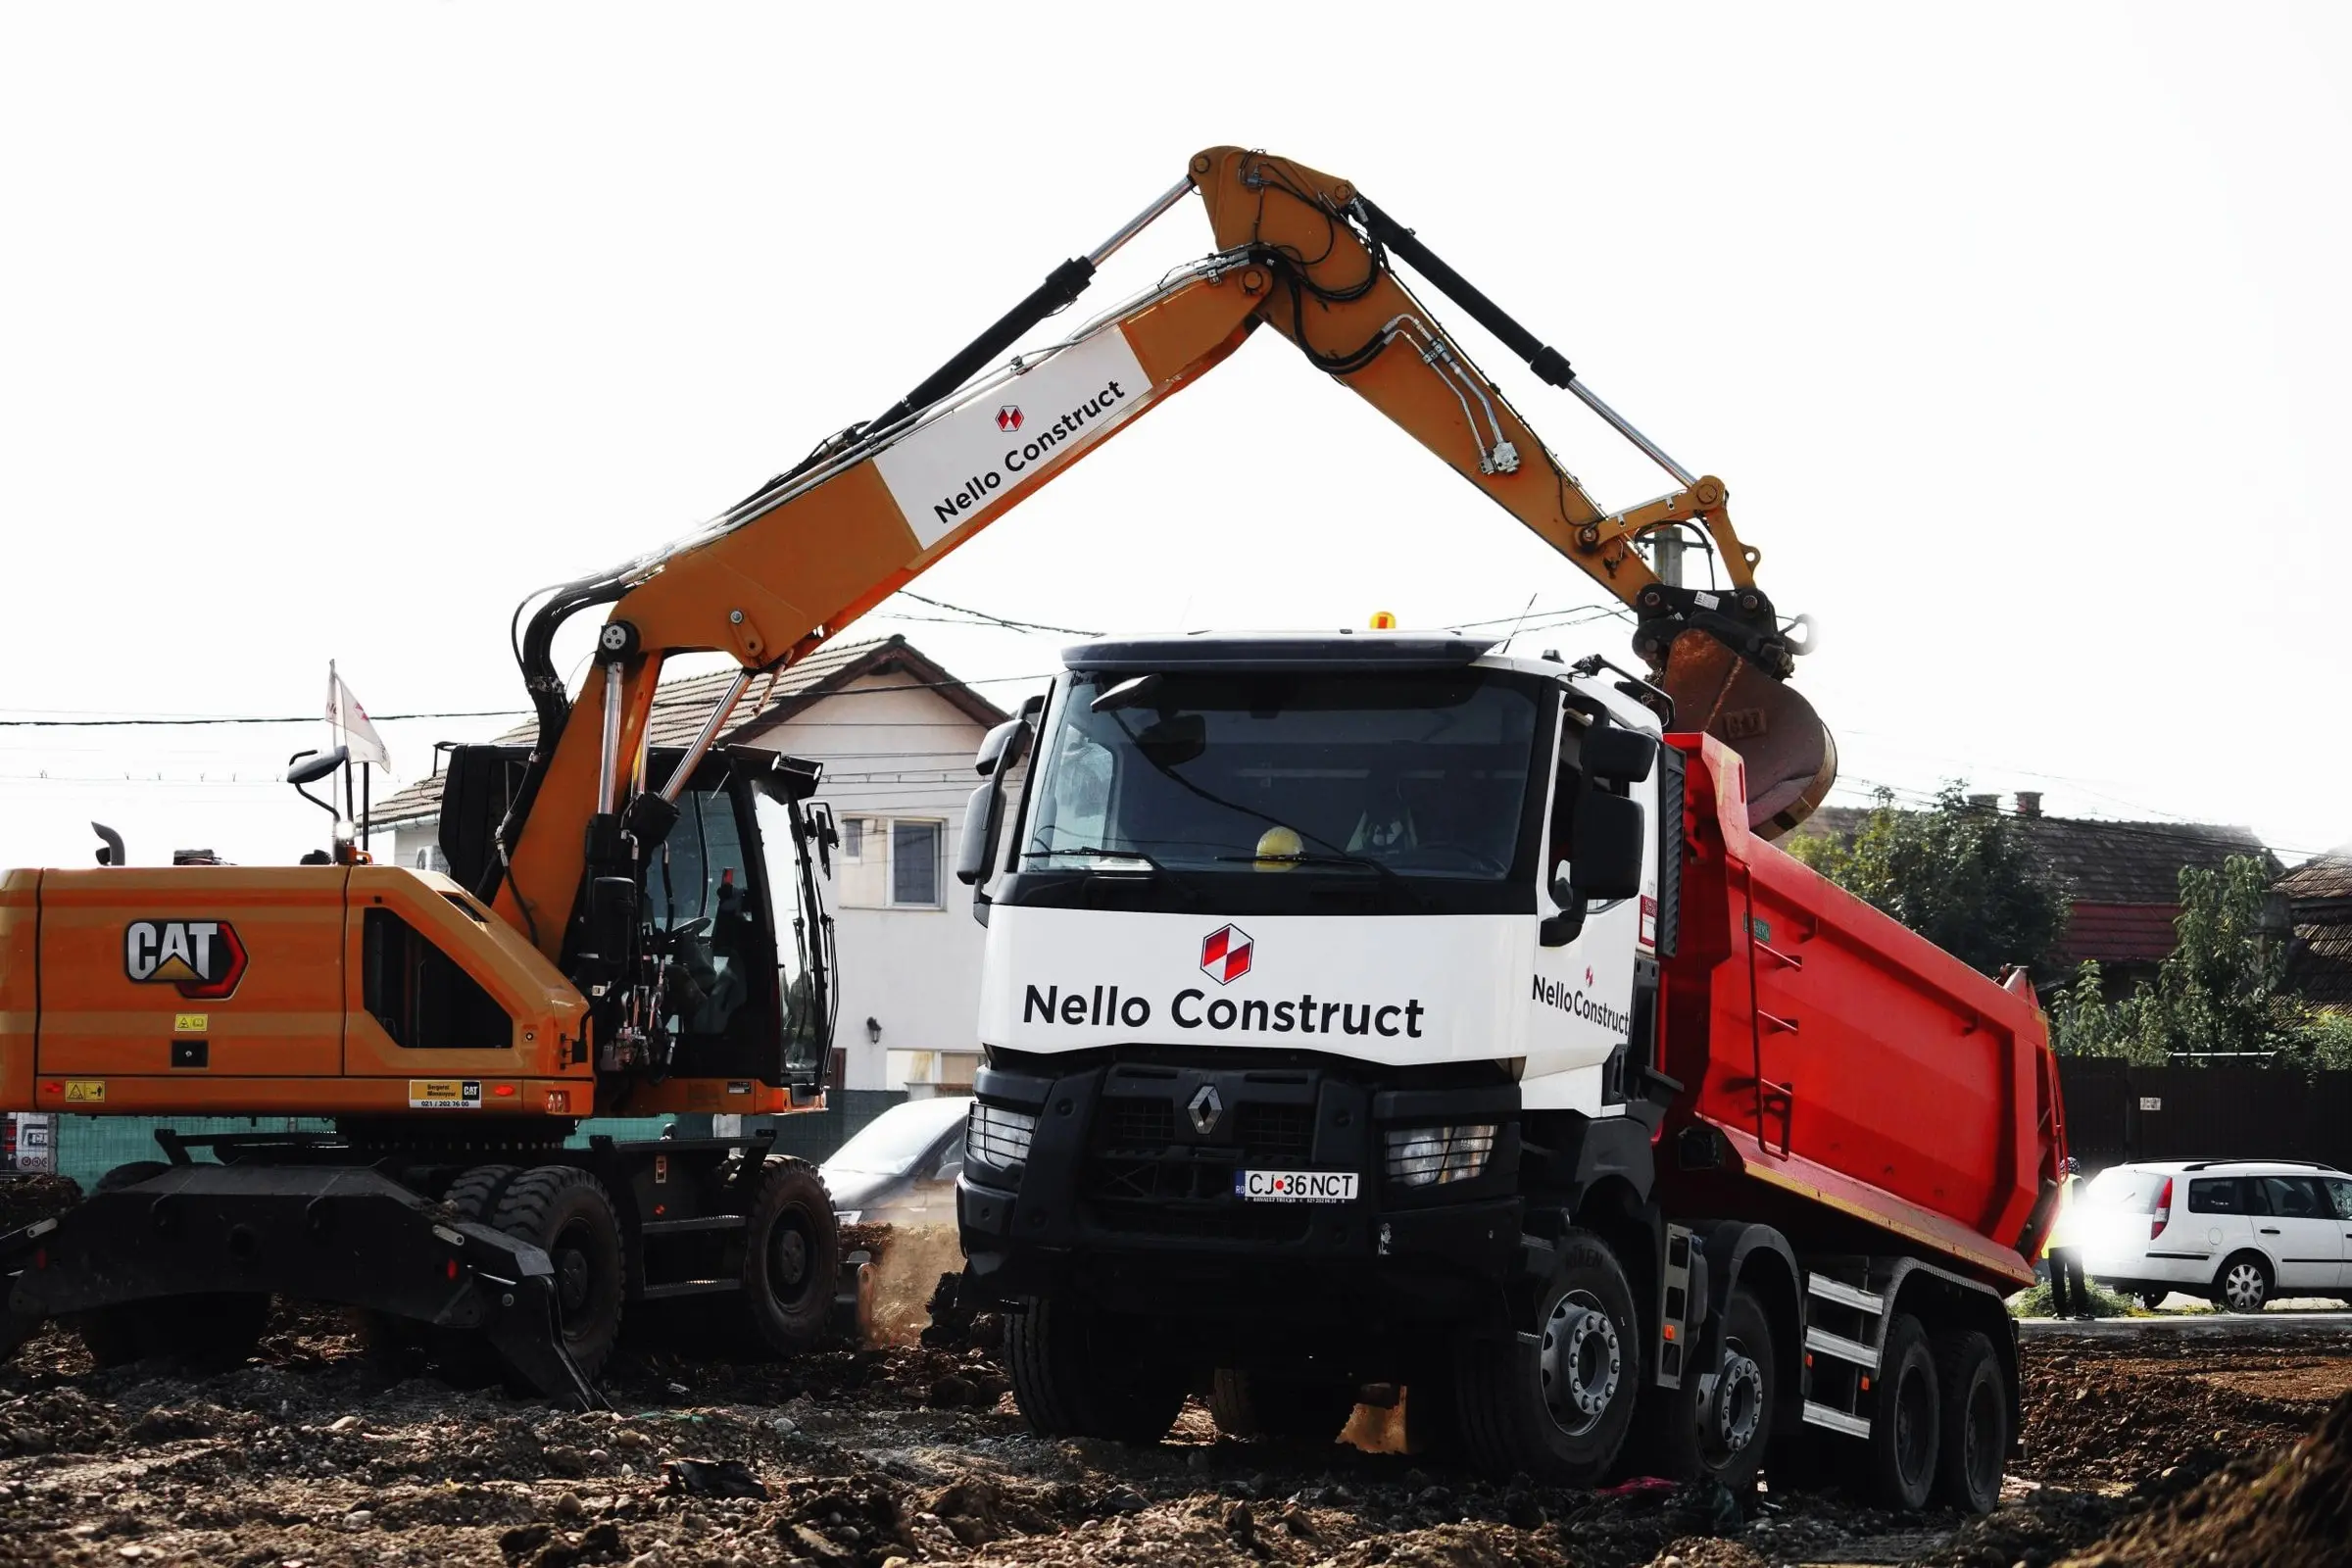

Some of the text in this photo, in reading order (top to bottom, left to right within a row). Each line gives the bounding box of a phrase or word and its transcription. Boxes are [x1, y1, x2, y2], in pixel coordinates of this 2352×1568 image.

[934, 380, 1125, 523] Nello Construct
[128, 922, 217, 981] CAT
[1023, 984, 1425, 1038] Nello Construct
[1532, 974, 1630, 1036] Nello Construct
[464, 1086, 478, 1096] CAT
[1235, 1185, 1245, 1194] RO
[1250, 1174, 1352, 1197] CJ 36 NCT
